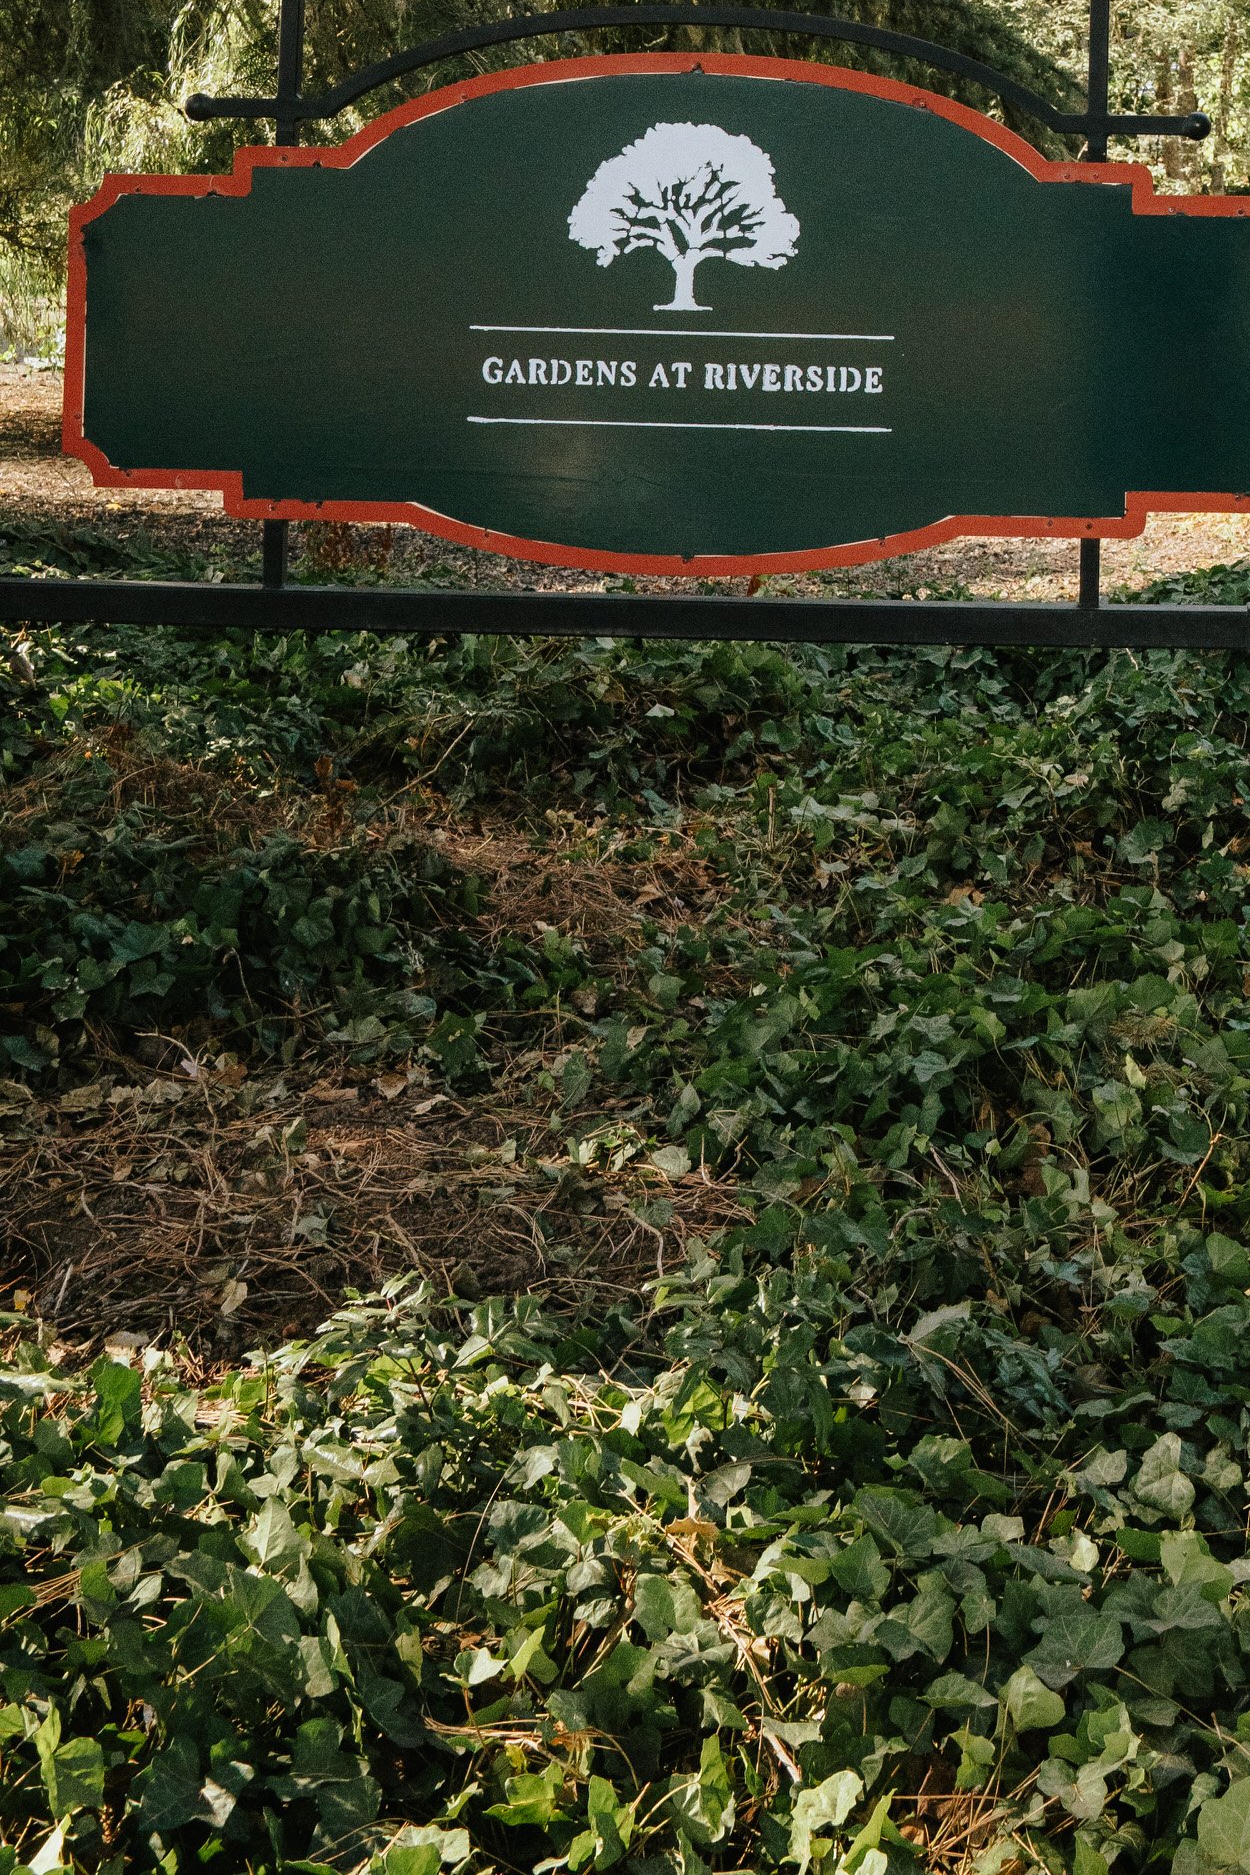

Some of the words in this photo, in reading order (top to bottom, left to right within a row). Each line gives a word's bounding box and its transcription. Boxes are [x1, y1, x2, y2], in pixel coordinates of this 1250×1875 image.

[483, 357, 636, 386] GARDENS
[649, 362, 692, 388] AT
[704, 363, 882, 393] RIVERSIDE
